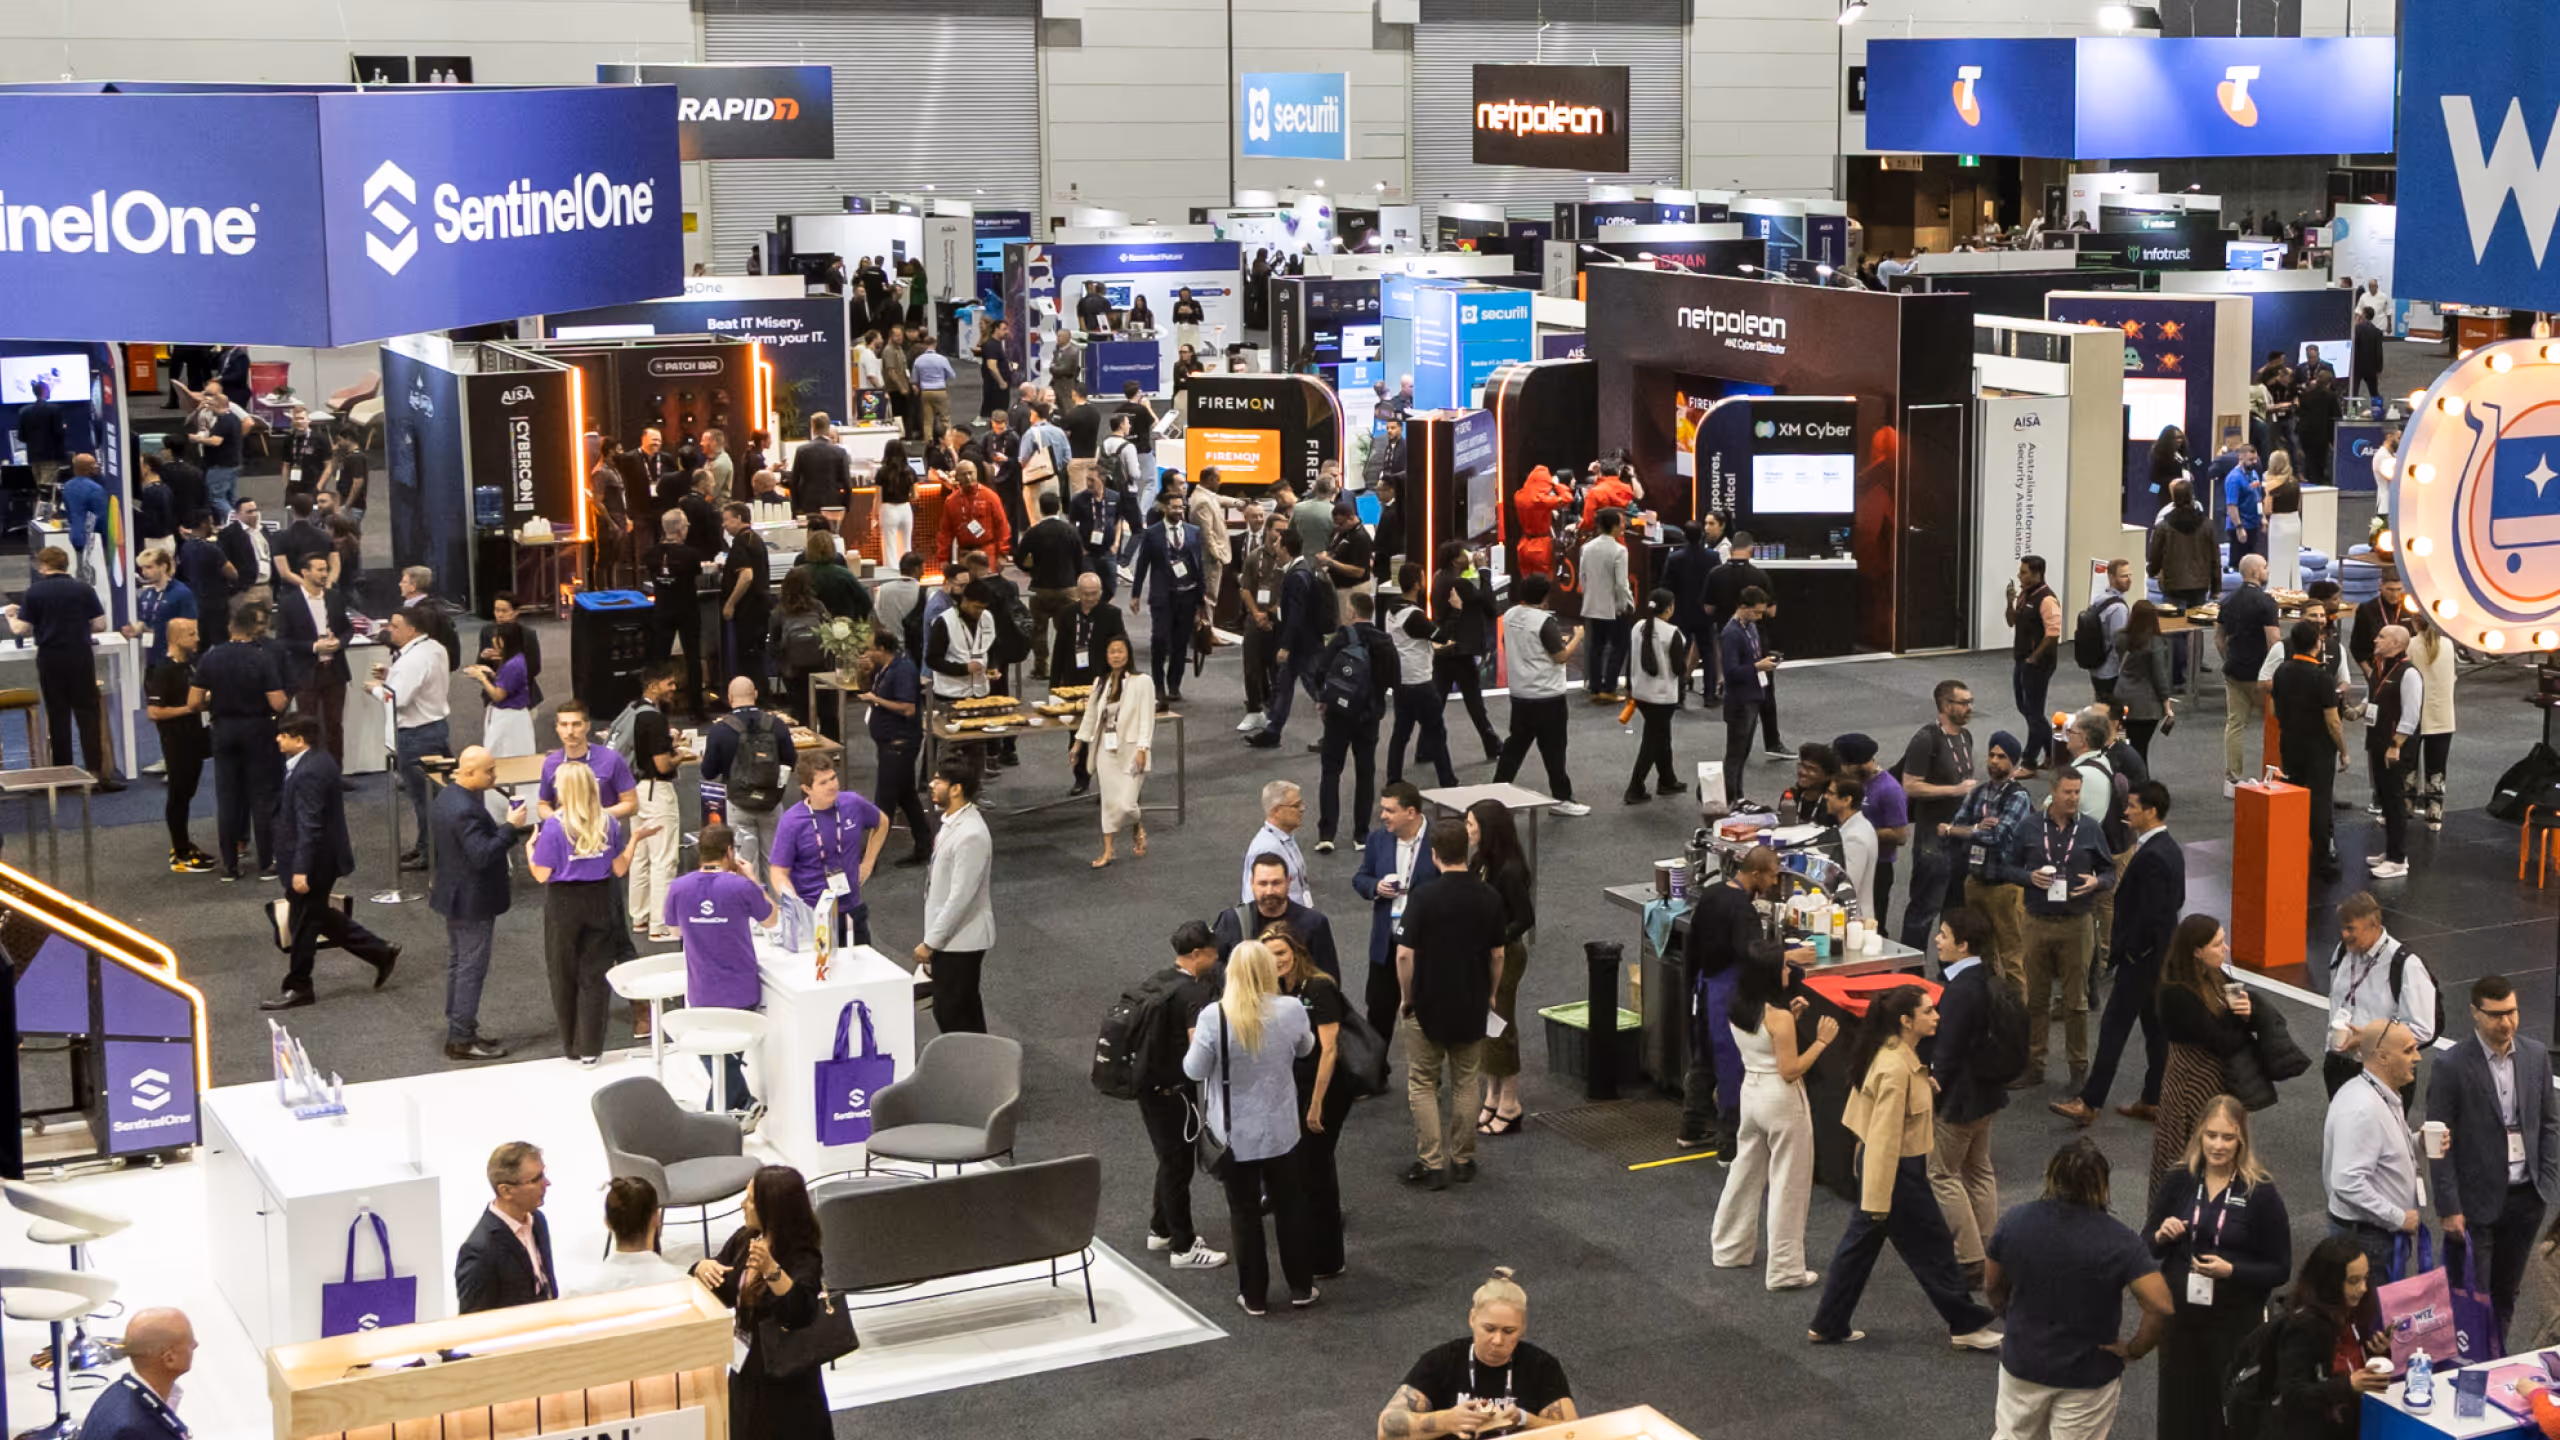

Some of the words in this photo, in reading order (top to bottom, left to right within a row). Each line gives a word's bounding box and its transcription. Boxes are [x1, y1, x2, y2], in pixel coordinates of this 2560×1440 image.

[1274, 95, 1339, 133] securiti
[1477, 98, 1603, 137] netpoleon
[434, 172, 653, 243] SentinelOne
[1481, 306, 1528, 320] securiti
[707, 318, 738, 330] Beat
[741, 318, 753, 328] IT
[755, 316, 804, 331] Misery.
[1678, 305, 1786, 339] netpoleon
[779, 334, 809, 346] your
[812, 331, 827, 342] IT.
[1567, 348, 1586, 357] AIS
[665, 362, 696, 371] PATCH
[697, 361, 718, 370] BAR
[501, 388, 535, 402] AISA
[1778, 423, 1801, 436] XM
[1806, 422, 1851, 439] Cyber
[2014, 416, 2041, 428] AISA
[2015, 443, 2026, 489] Security
[2026, 442, 2036, 501] Australian
[2014, 492, 2024, 560] Association
[113, 1114, 192, 1132] SentinelOne
